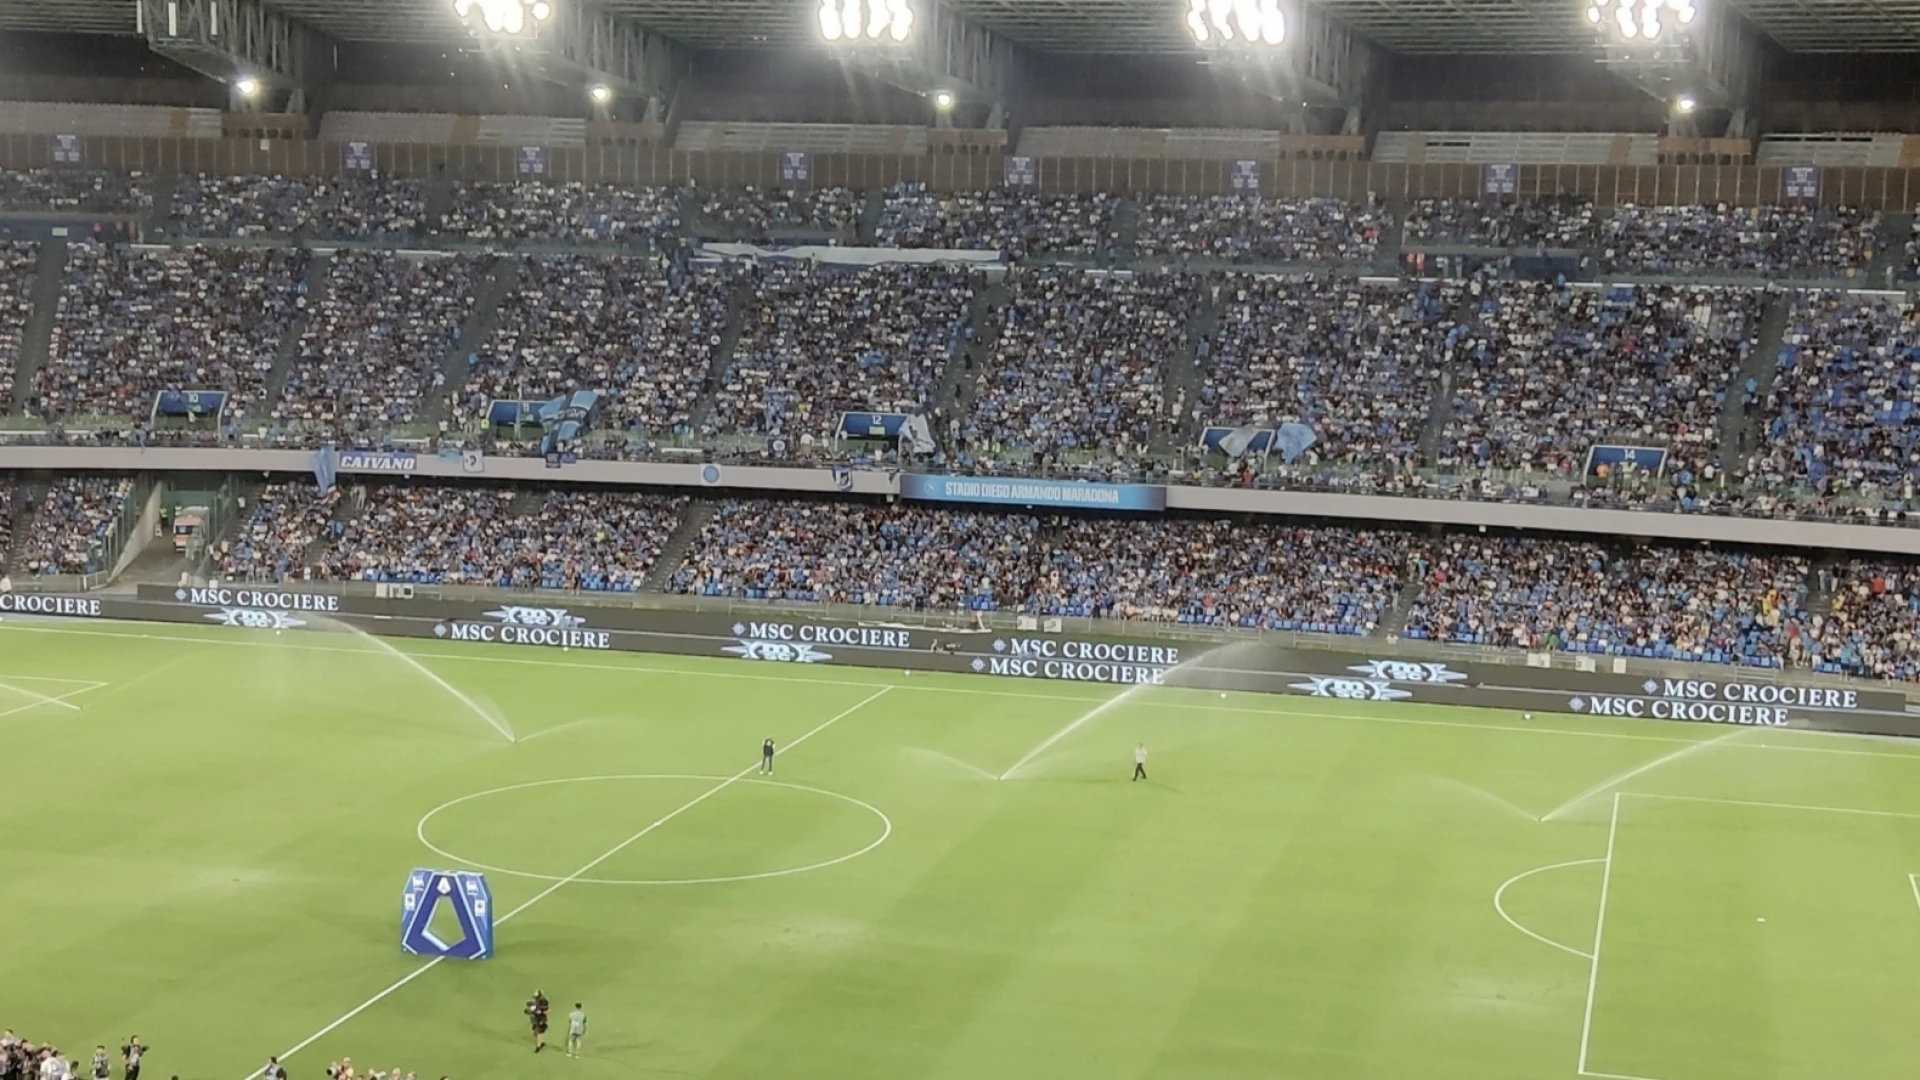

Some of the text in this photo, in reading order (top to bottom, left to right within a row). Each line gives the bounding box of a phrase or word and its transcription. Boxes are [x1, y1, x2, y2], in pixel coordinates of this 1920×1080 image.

[188, 393, 199, 403] 10
[872, 415, 882, 425] 12
[341, 456, 415, 470] CAIVANO
[1624, 448, 1635, 459] 14
[945, 481, 1119, 504] STADIO DIEGO ARMANDO MARADONA
[0, 593, 102, 616] CROCIERE
[190, 587, 339, 612] MSC CROCIERE
[450, 622, 611, 648] MSC CROCIERE
[749, 621, 910, 647] MSC CROCIERE
[1010, 638, 1179, 663] MSC CROCIERE
[989, 657, 1165, 684] MSC CROCIERE
[1662, 678, 1858, 709] MSC CROCIERE
[1589, 696, 1789, 726] MSC CROCIERE
